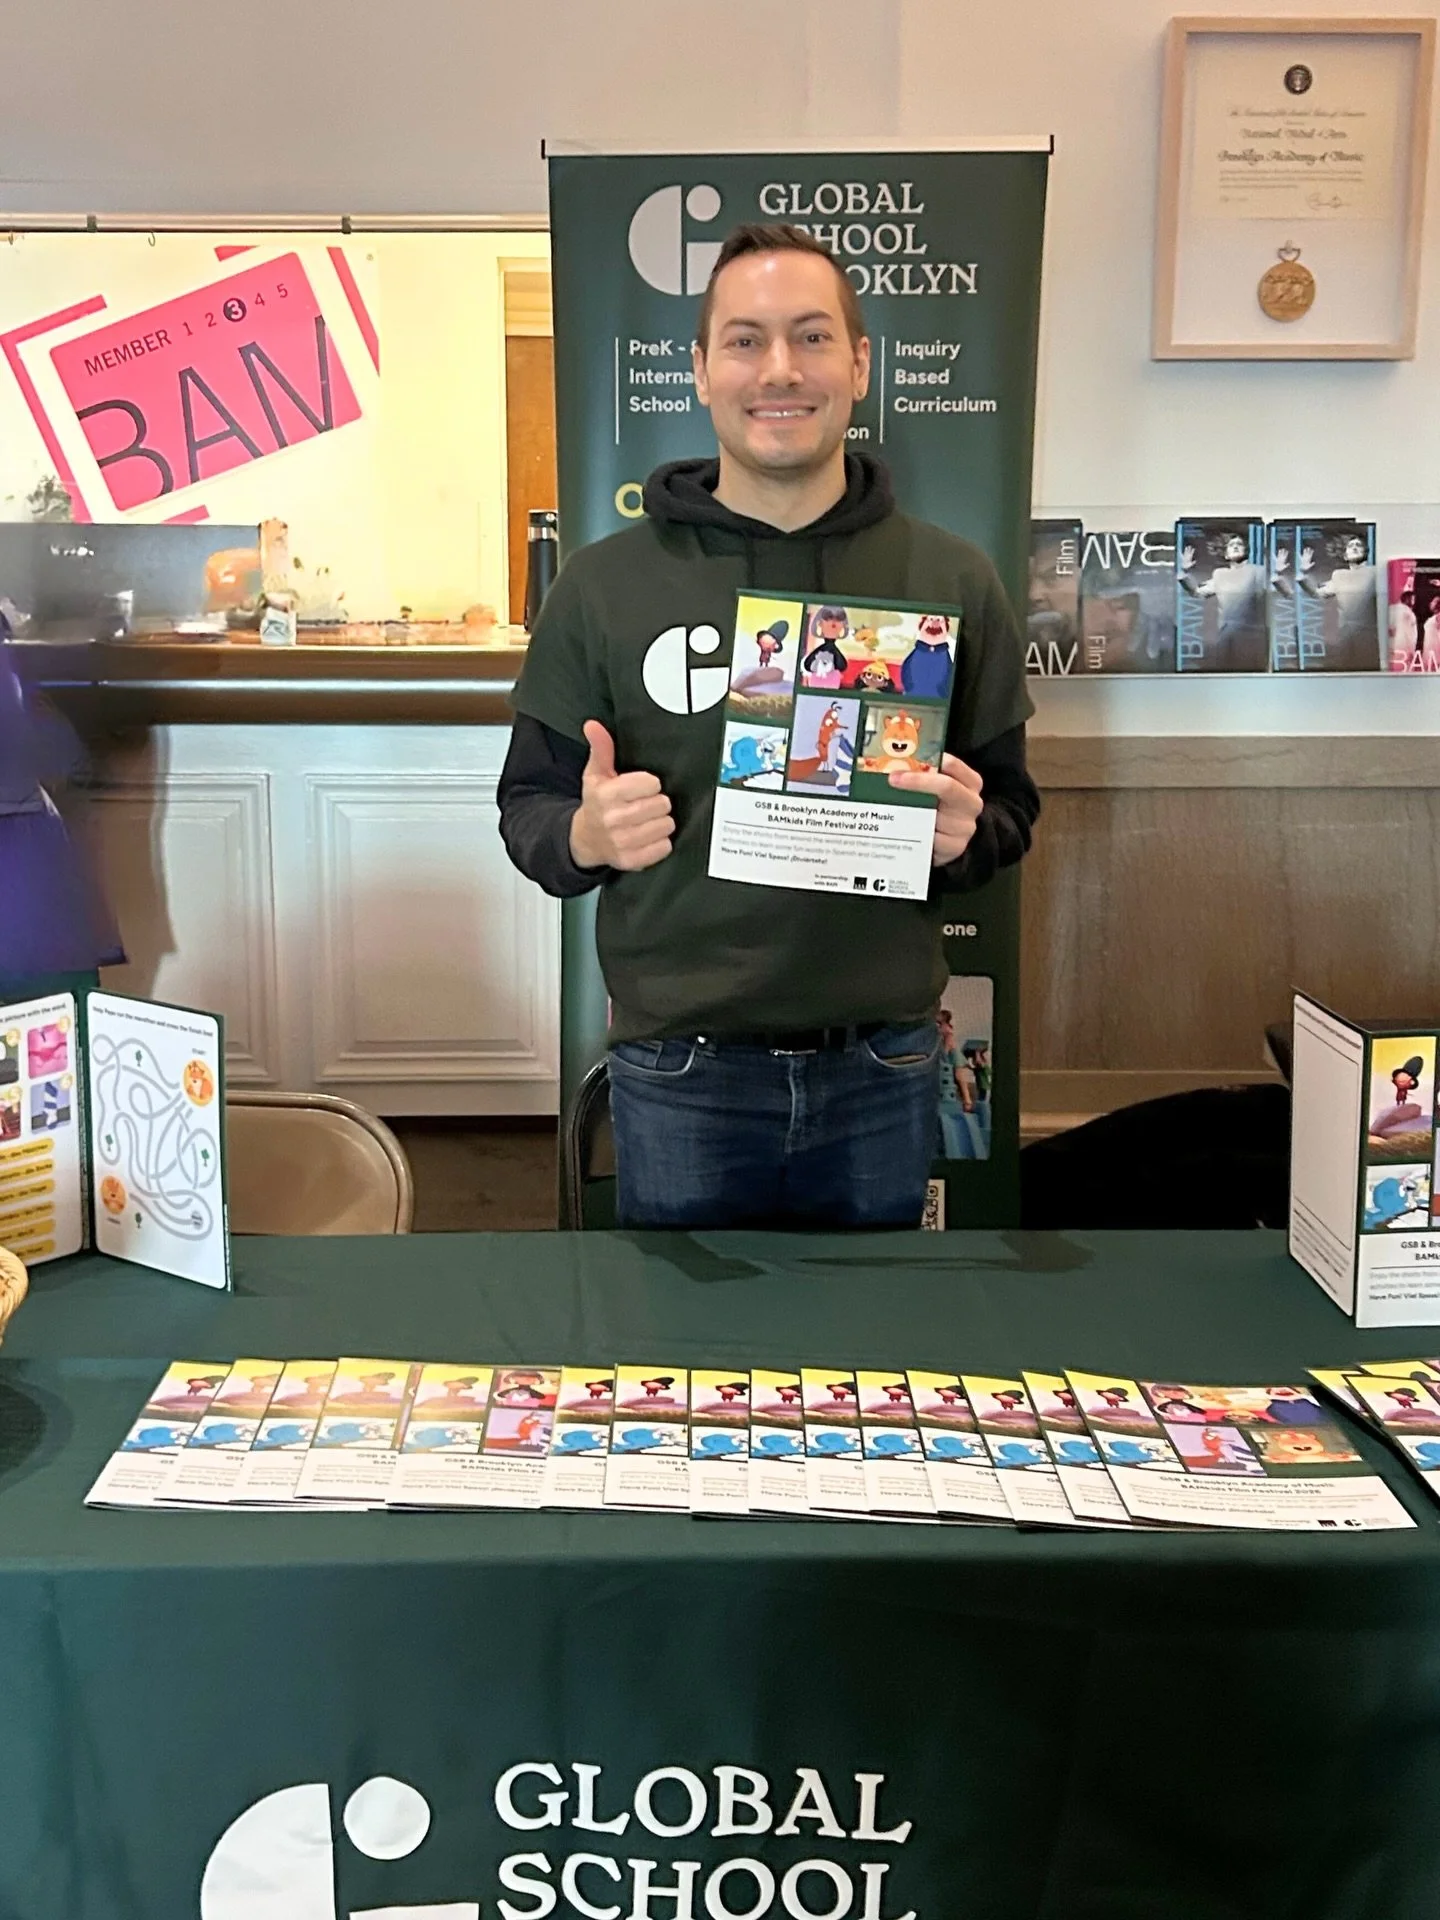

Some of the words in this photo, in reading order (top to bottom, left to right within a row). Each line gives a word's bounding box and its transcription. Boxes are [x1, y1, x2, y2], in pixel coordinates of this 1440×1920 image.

[759, 182, 925, 215] GLOBAL
[84, 329, 172, 376] MEMBER
[182, 322, 193, 336] 1
[205, 312, 217, 327] 2
[226, 299, 245, 320] 3
[255, 293, 265, 307] 4
[276, 284, 288, 299] 5
[629, 340, 673, 356] PreK
[895, 340, 961, 360] Inquiry
[629, 368, 696, 384] Interna
[894, 368, 950, 385] Based
[75, 315, 333, 498] BAM
[629, 396, 691, 413] School
[894, 396, 997, 413] Curriculum
[1056, 539, 1075, 575] Film
[1088, 635, 1105, 669] Film
[755, 801, 772, 809] GSB
[774, 803, 779, 811] &
[782, 804, 818, 815] Brooklyn
[820, 807, 858, 819] Academy
[860, 811, 868, 819] of
[871, 812, 894, 821] Music
[768, 815, 803, 825] BAMkids
[806, 819, 823, 827] Film
[825, 820, 856, 830] Festival
[858, 823, 879, 831] 2026
[1401, 1241, 1418, 1249] GSB
[494, 1762, 912, 1844] GLOBAL
[497, 1852, 918, 1920] SCHOOL
